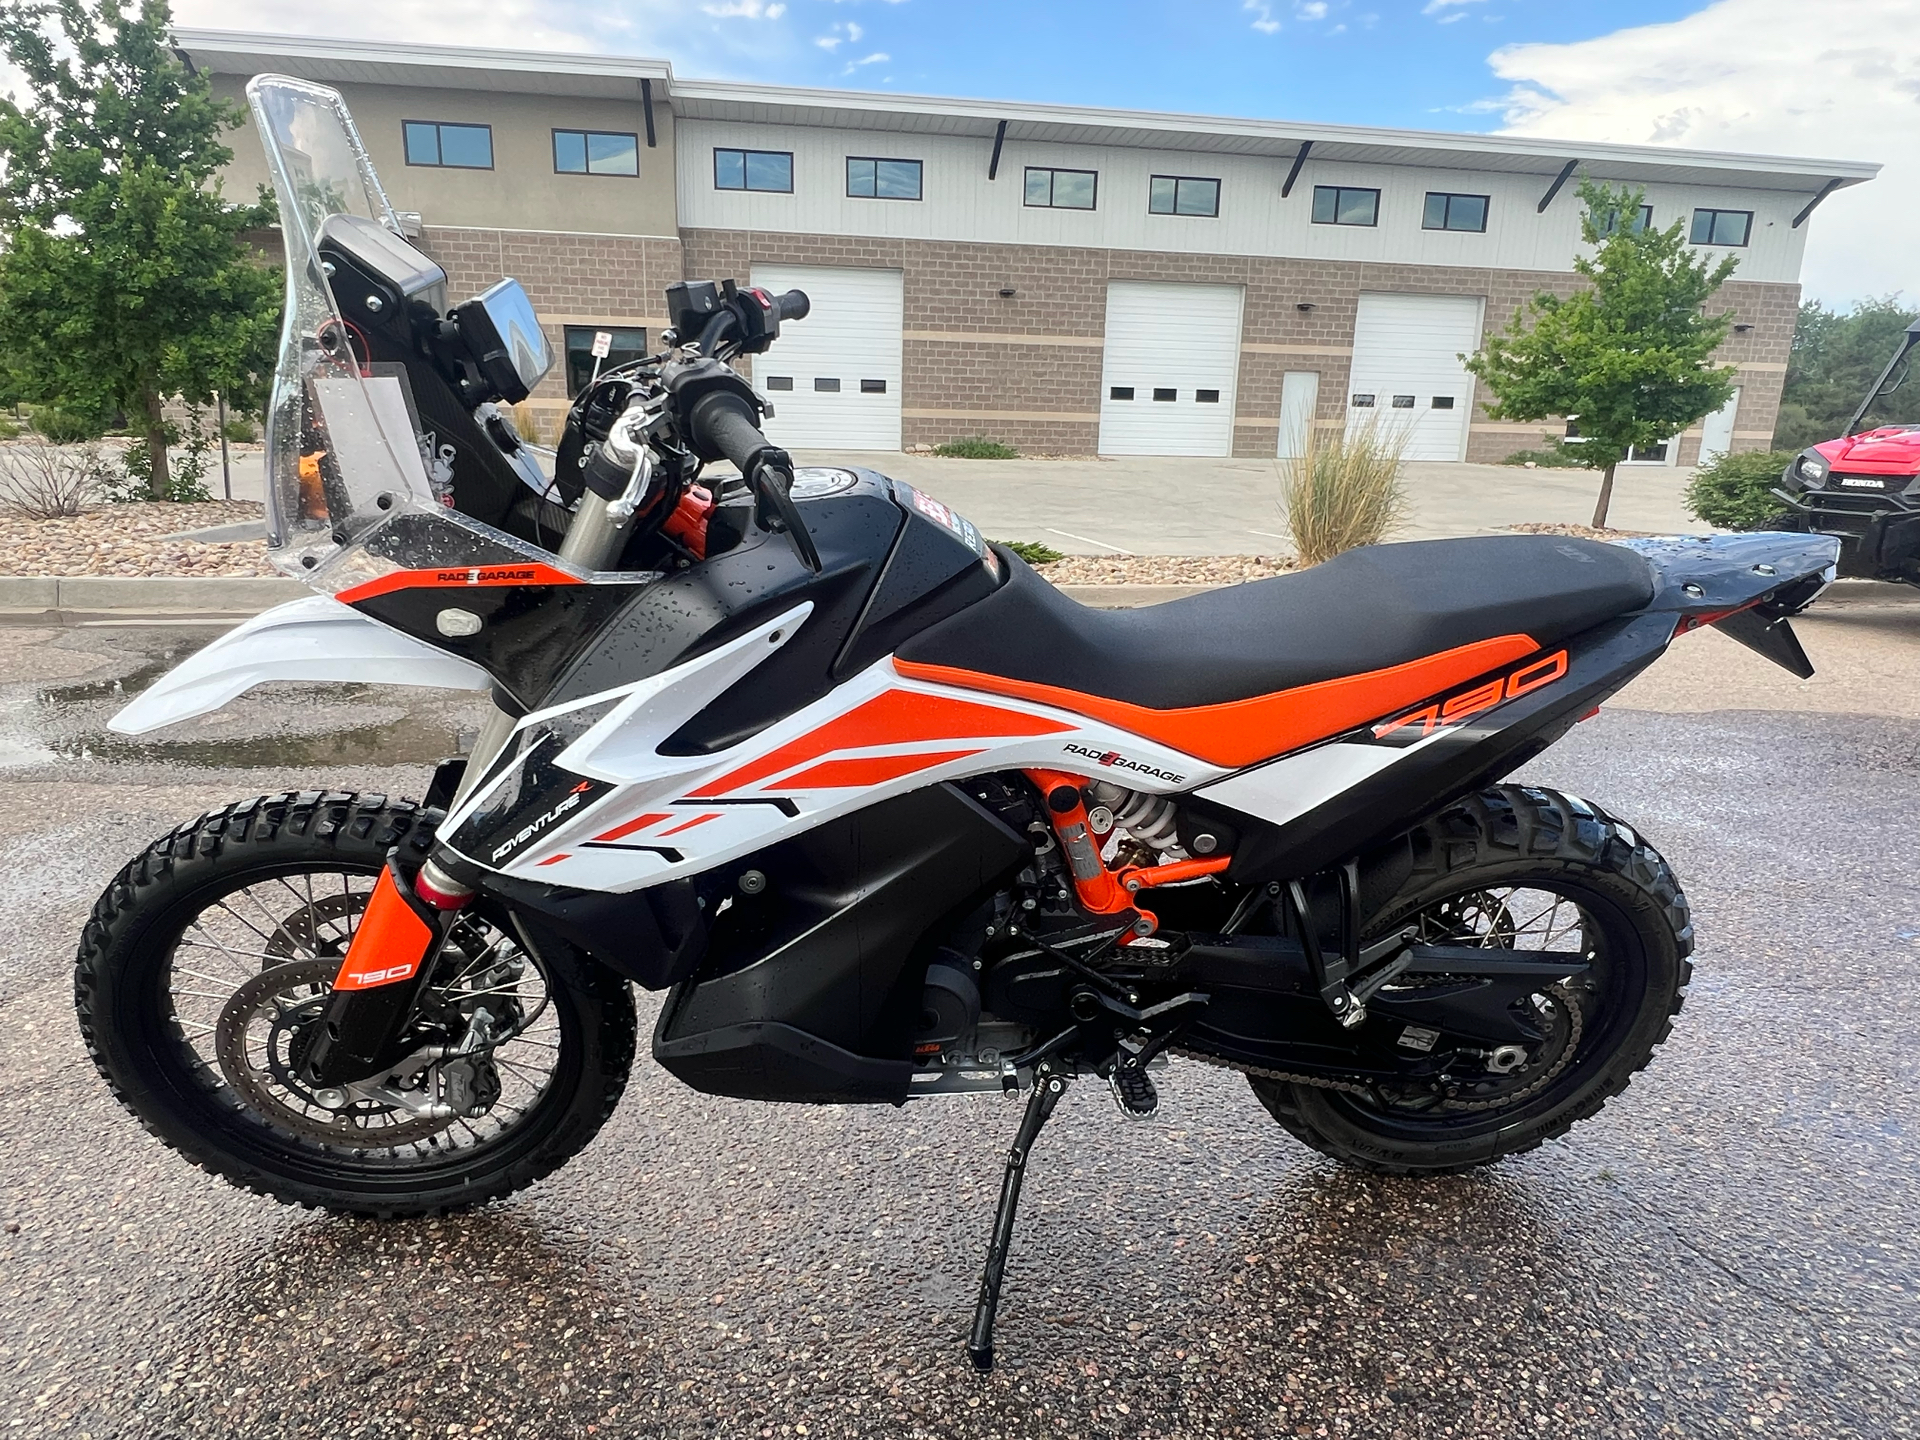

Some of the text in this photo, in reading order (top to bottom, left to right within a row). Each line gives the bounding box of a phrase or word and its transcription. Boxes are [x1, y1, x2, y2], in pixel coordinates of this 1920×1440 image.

[1841, 478, 1885, 488] HONDA
[437, 571, 536, 582] RADE GARAGE
[1371, 649, 1568, 740] 790
[1063, 743, 1187, 784] RADE GARAGE
[492, 792, 580, 863] ADVENTURE
[348, 963, 412, 985] 790
